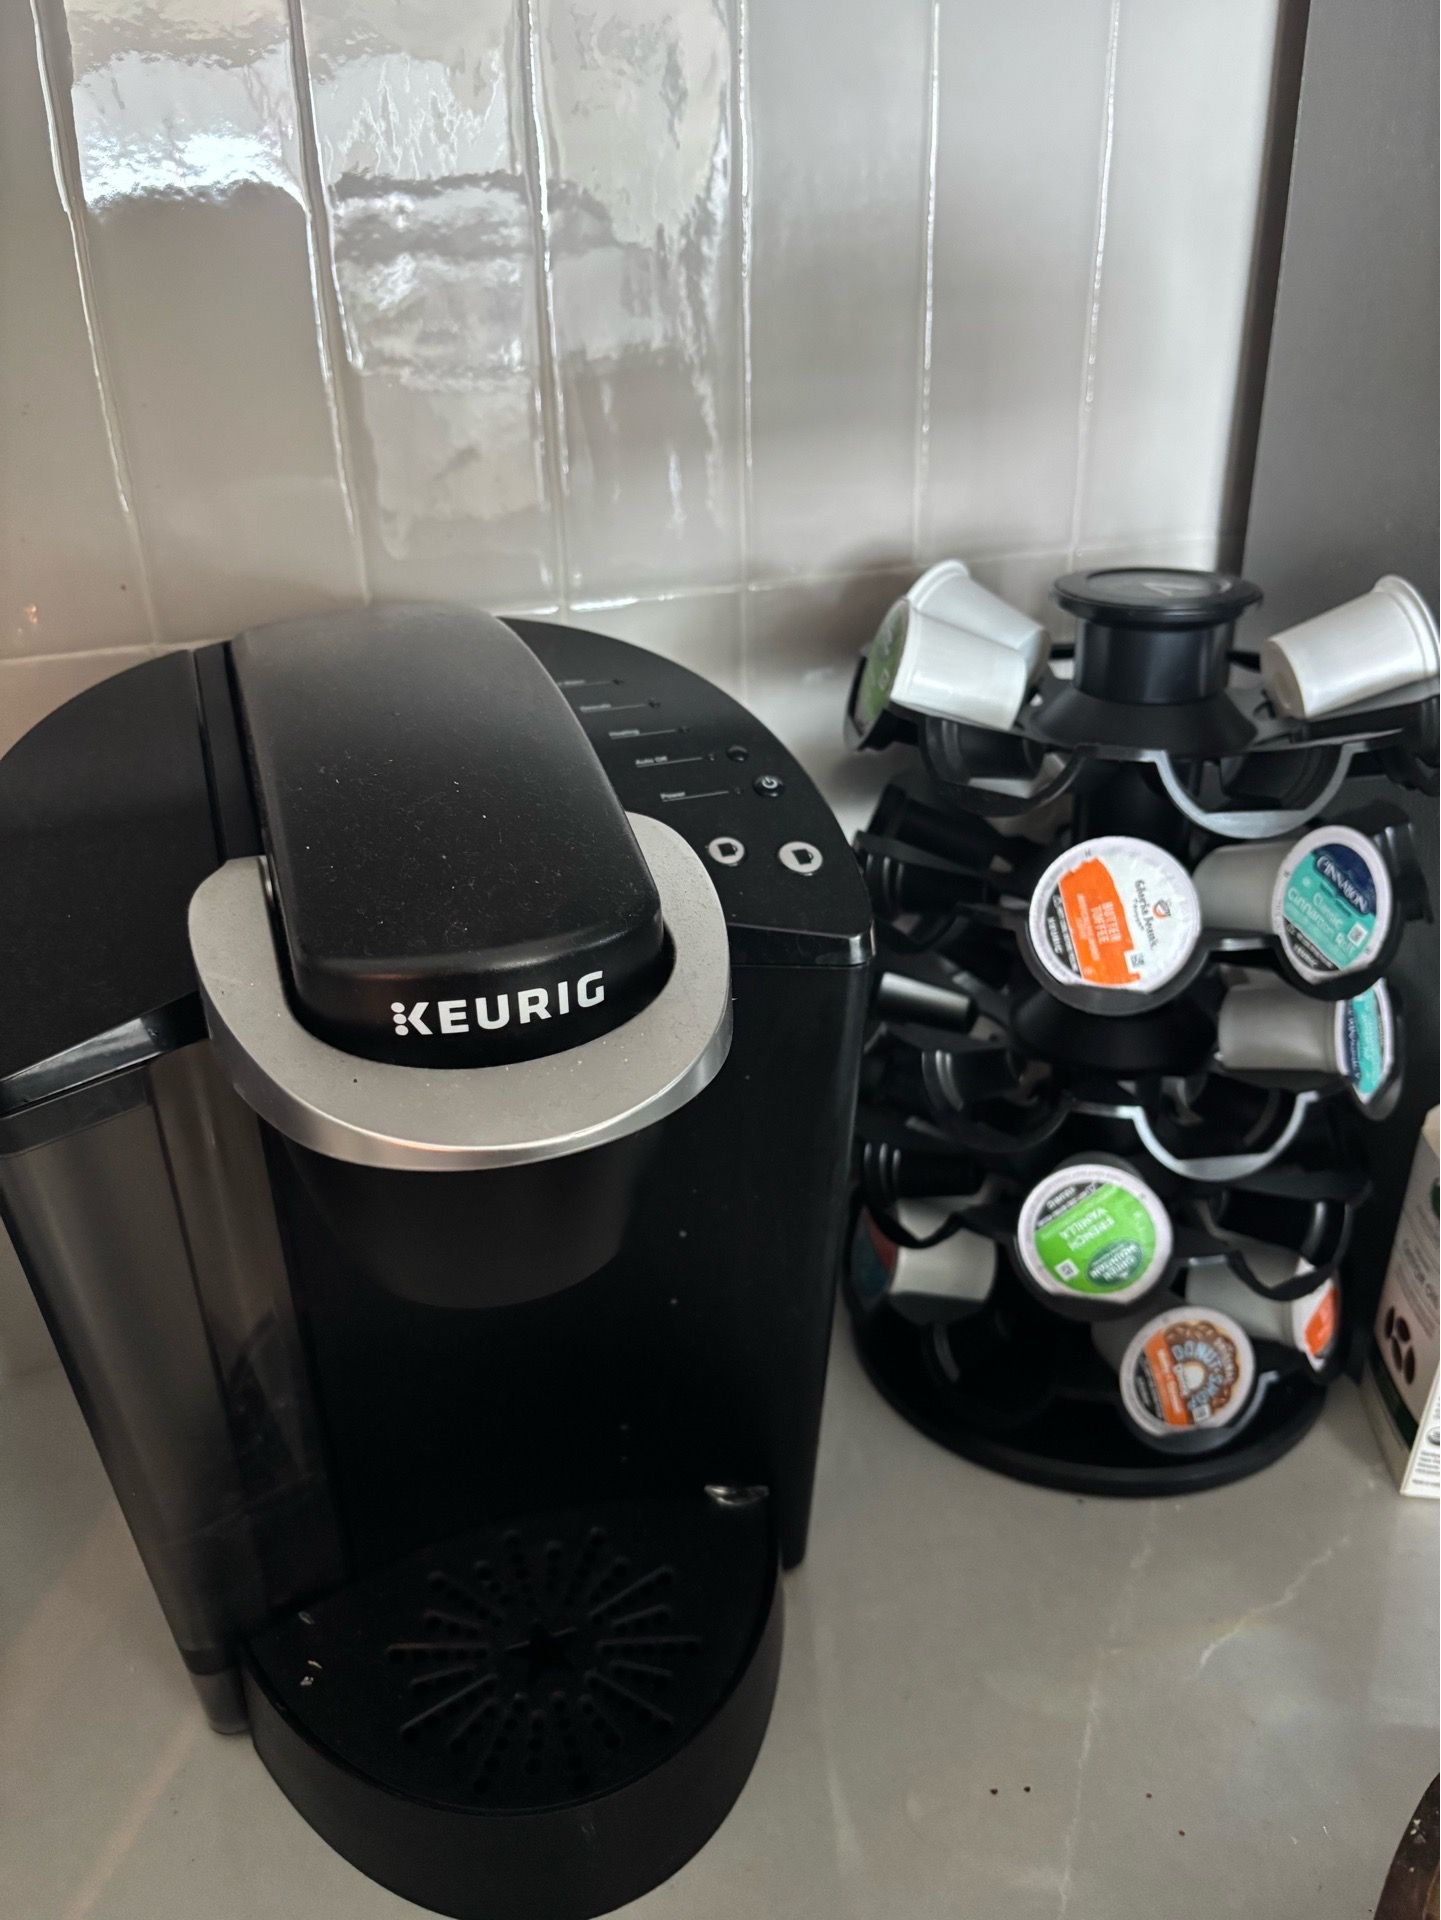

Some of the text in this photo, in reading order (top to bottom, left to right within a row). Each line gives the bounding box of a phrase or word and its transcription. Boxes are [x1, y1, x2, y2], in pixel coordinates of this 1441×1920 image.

[1092, 906, 1110, 943] TOFFEE
[1102, 901, 1122, 942] BUTTER
[391, 970, 605, 1036] KEURIG
[1060, 1207, 1108, 1240] VANILLA
